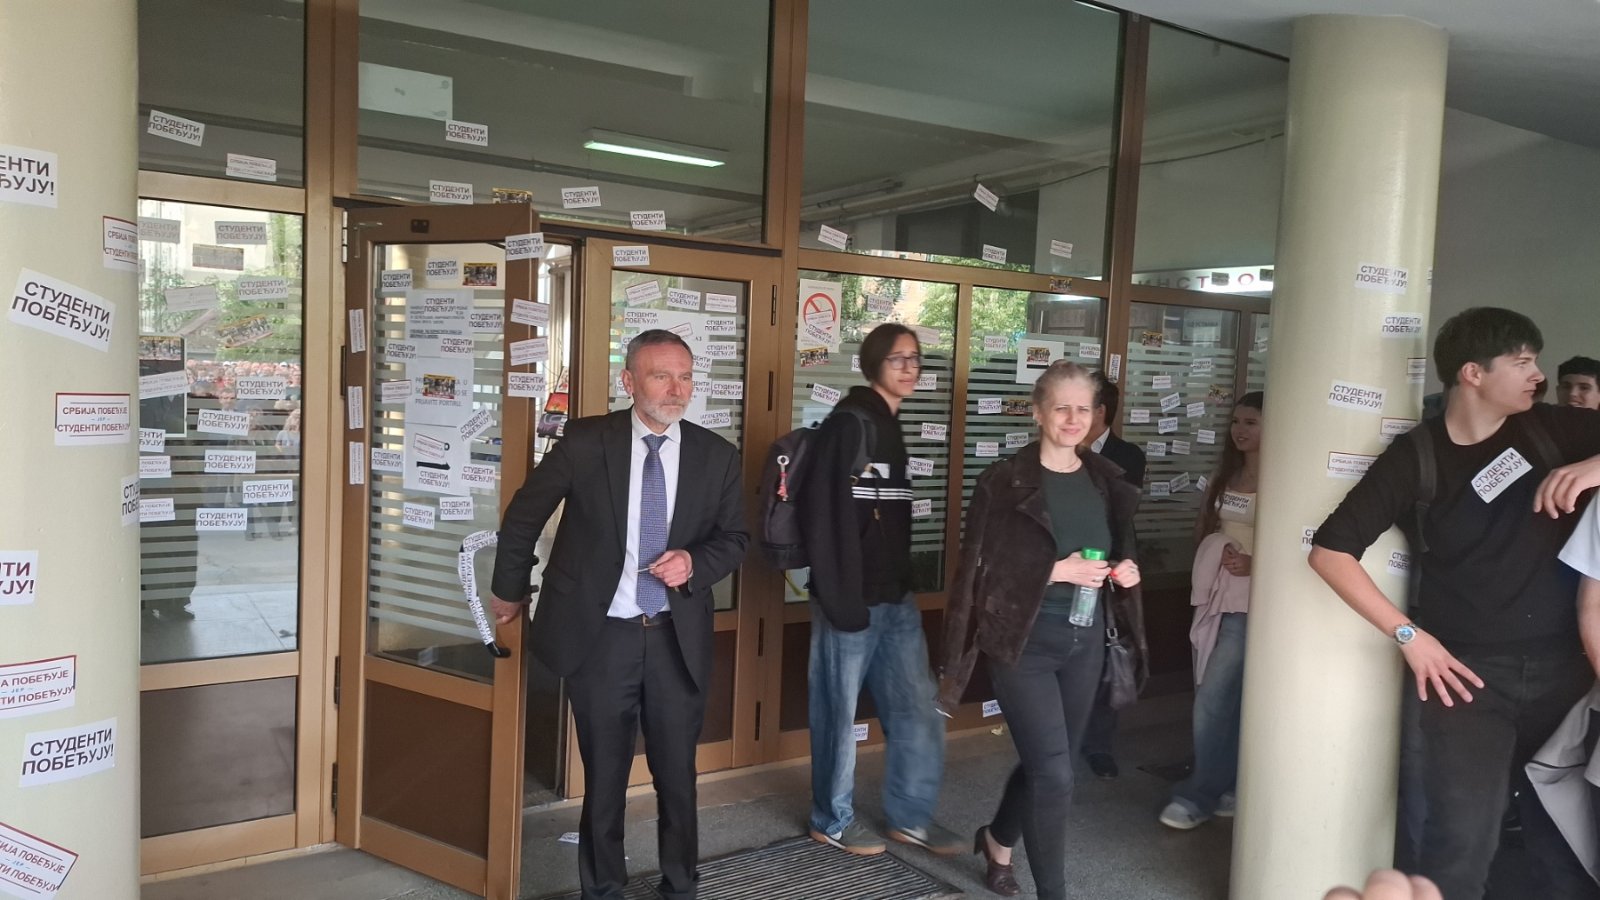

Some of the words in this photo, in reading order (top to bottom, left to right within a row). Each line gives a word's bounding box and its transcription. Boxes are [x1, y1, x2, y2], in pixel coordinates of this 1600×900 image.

[149, 121, 201, 142] ПОБЕЂУЈУ!
[152, 114, 200, 134] СТУДЕНТИ
[448, 123, 485, 136] СТУДЕНТИ
[432, 184, 470, 194] СТУДЕНТИ
[564, 190, 598, 198] СТУДЕНТИ
[218, 224, 263, 232] СТУДЕНТИ
[507, 238, 542, 248] СТУДЕНТИ
[240, 280, 284, 288] СТУДЕНТИ
[24, 281, 110, 324] СТУДЕНТИ
[12, 296, 110, 342] ПОБЕЂУЈУ!
[238, 380, 284, 388] СТУДЕНТИ
[1333, 384, 1382, 400] СТУДЕНТИ
[1328, 392, 1382, 410] ПОБЕЂУЈУ!
[62, 406, 96, 415] СРБИЈА
[201, 412, 248, 422] СТУДЕНТИ
[56, 424, 100, 434] СТУДЕНТИ
[198, 419, 248, 430] ПОБЕЂУЈУ!
[460, 409, 488, 434] СТУДЕНТИ
[463, 466, 494, 475] СТУДЕНТИ
[1474, 452, 1518, 488] СТУДЕНТИ
[1476, 458, 1528, 496] ПОБЕЂУЈУ!
[245, 483, 290, 492] СТУДЕНТИ
[404, 507, 433, 518] СТУДЕНТИ
[12, 670, 69, 686] ПОБЕЂУЈЕ
[18, 686, 74, 703] ПОБЕЂУЈУ
[30, 728, 112, 756] СТУДЕНТИ
[22, 744, 114, 775] ПОБЕЂУЈУ!
[18, 850, 66, 874] ПОБЕЂУЈЕ
[10, 869, 59, 892] ПОБЕЂУЈУ
